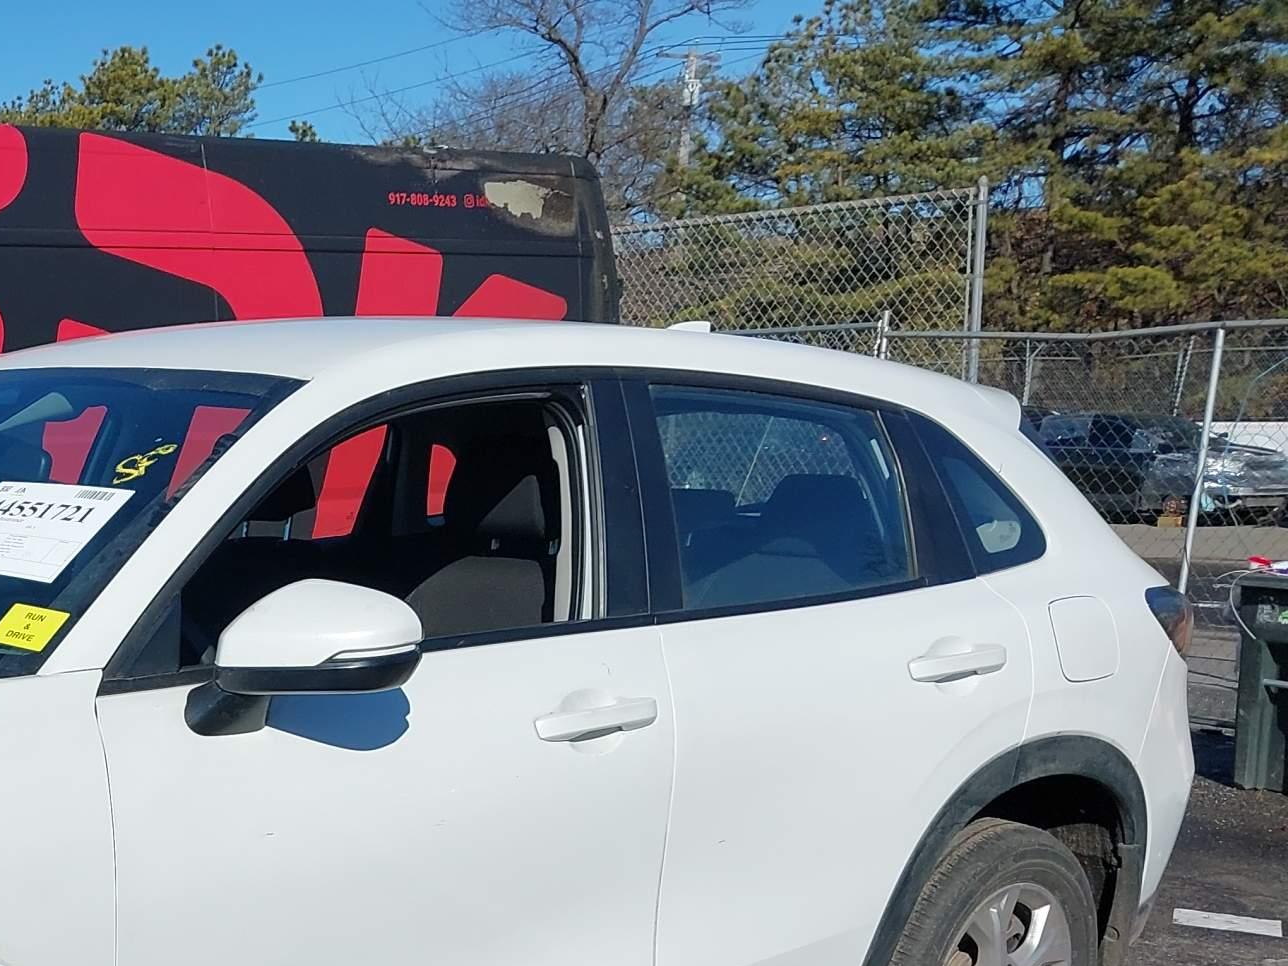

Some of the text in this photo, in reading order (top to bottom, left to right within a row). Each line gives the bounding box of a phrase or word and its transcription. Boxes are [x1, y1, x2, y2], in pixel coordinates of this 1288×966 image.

[387, 193, 457, 207] 917-808-9243
[24, 612, 47, 622] RUN
[5, 630, 36, 642] DRIVE
